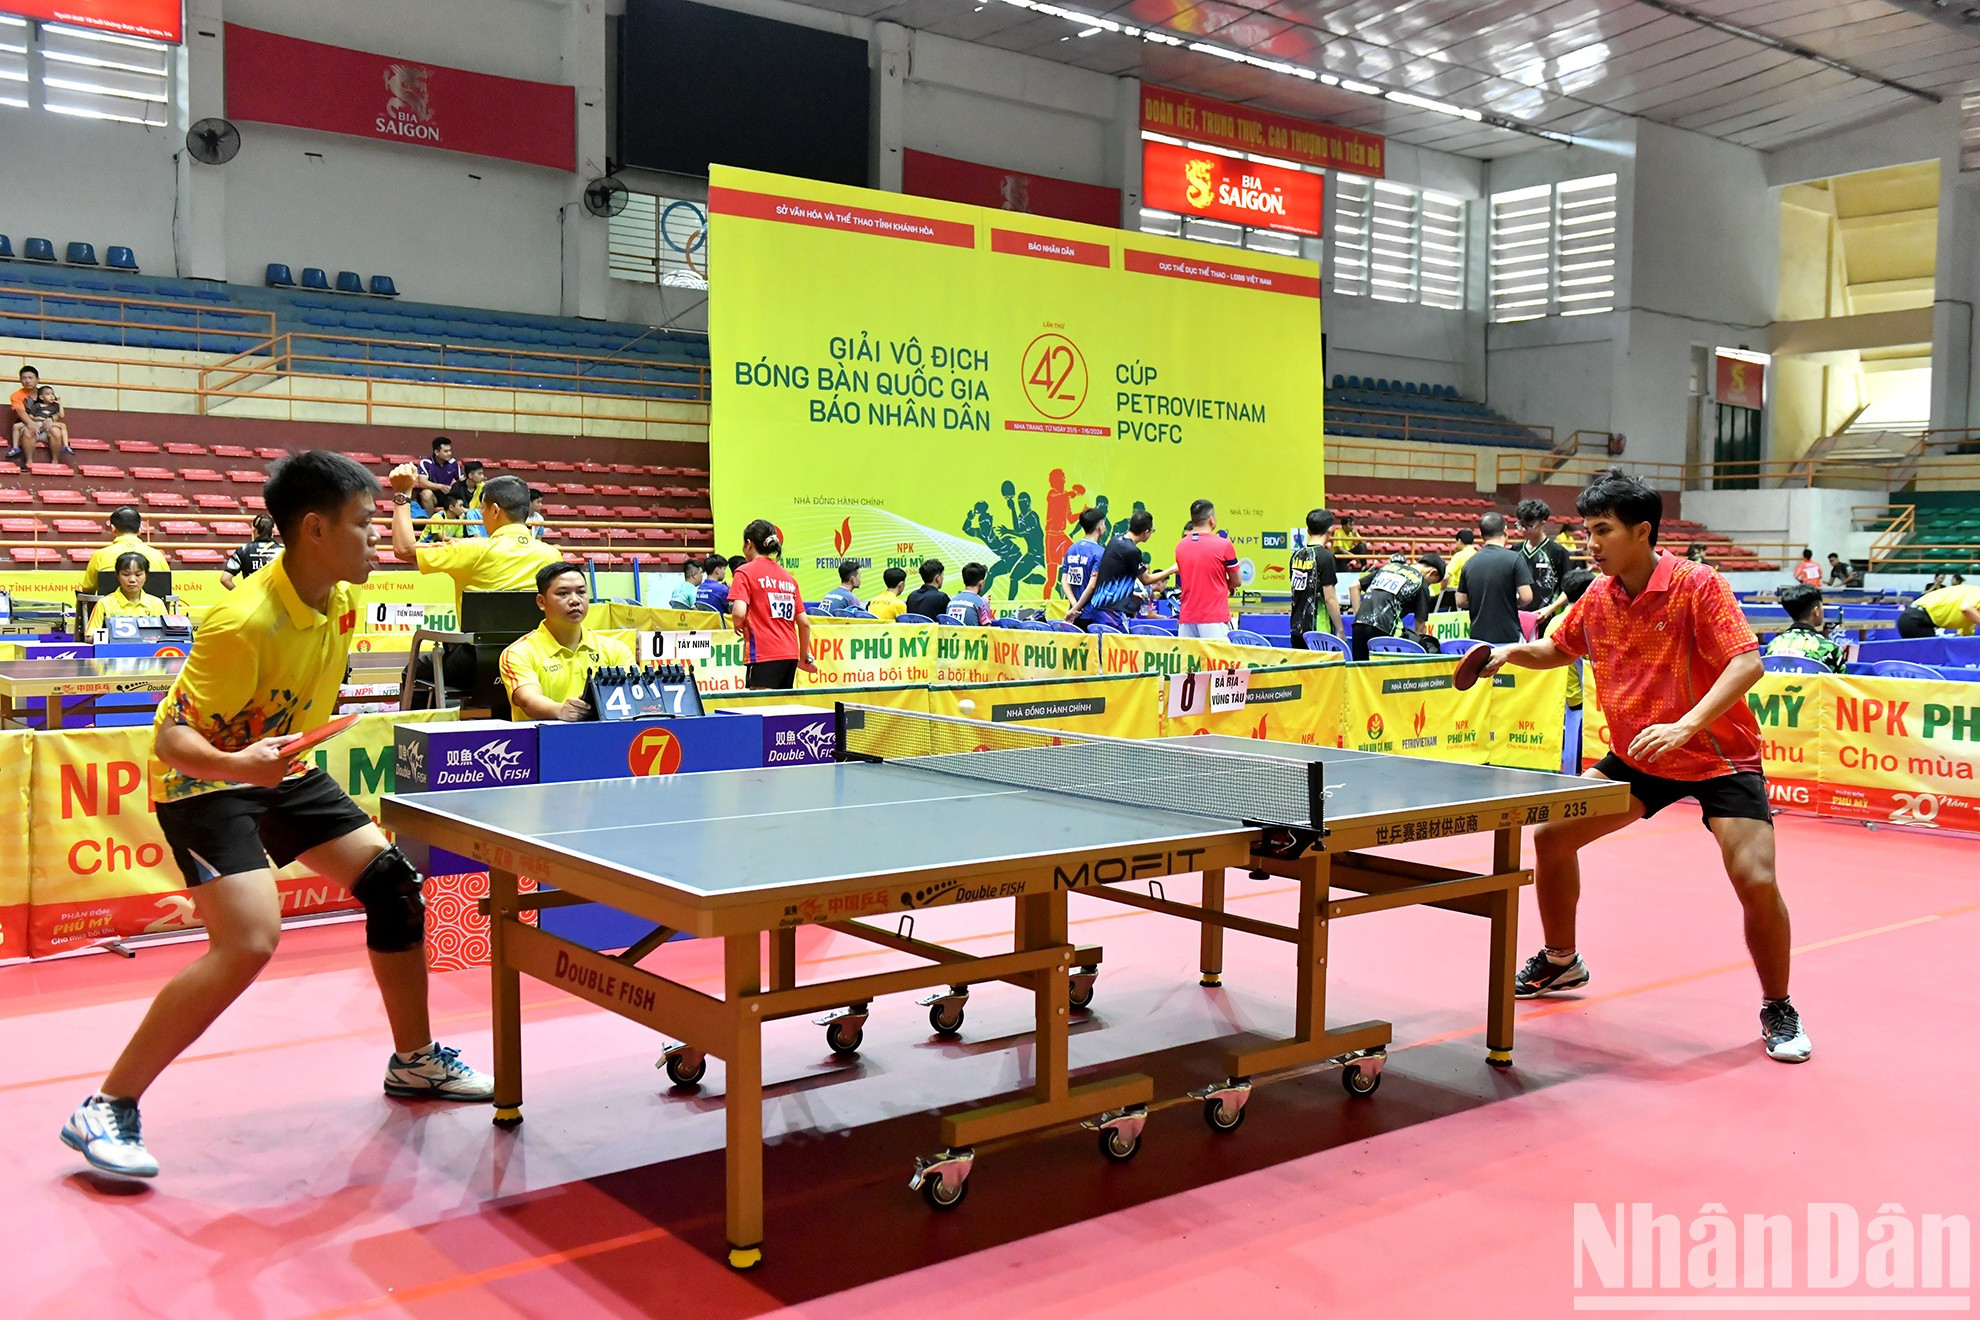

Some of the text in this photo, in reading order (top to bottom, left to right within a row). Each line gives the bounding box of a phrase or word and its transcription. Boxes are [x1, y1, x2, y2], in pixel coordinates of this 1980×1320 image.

[398, 112, 418, 122] BIA
[376, 118, 440, 141] SAIGON
[1202, 110, 1234, 138] TRUNG
[1268, 126, 1288, 148] CAO
[1242, 175, 1262, 190] BIA
[806, 210, 822, 220] HÓA
[824, 210, 834, 221] VÀ
[836, 212, 852, 224] THỂ
[853, 216, 874, 227] THAO
[893, 222, 918, 234] KHÁNH
[920, 226, 934, 236] HÒA
[1028, 242, 1074, 256] BÁO NHÂN DÂN
[1211, 270, 1226, 278] THAO
[1246, 274, 1258, 284] VIỆT
[829, 330, 989, 374] GIẢI VÔ ĐỊCH
[735, 356, 990, 402] BÓNG BÀN QUỐC GIA
[1028, 344, 1076, 400] 42
[1116, 359, 1158, 386] CÚP
[809, 394, 990, 432] BÁO NHÂN DÂN
[1116, 392, 1266, 424] PETROVIETNAM
[1117, 420, 1182, 444] PVCFC
[794, 494, 885, 506] NHÀ ĐỒNG HÀNH CHÍNH
[896, 543, 914, 554] NPK
[1230, 536, 1260, 544] VNPT
[887, 554, 925, 568] PHÚ MỸ
[34, 582, 69, 592] KHÁNH
[184, 581, 202, 592] DÂN
[377, 582, 394, 592] VIỆT
[758, 576, 777, 589] TÂY
[376, 604, 386, 622] 0
[408, 610, 424, 618] GIANG
[96, 630, 106, 642] T
[114, 617, 138, 637] 5
[1438, 618, 1460, 640] PHÚ
[652, 632, 664, 658] 0
[678, 639, 710, 649] TÂY NINH
[808, 630, 930, 662] NPK PHÚ MỸ
[938, 636, 958, 661] HÚ
[994, 640, 1090, 671] NPK PHÚ MỸ
[1108, 647, 1181, 674] NPK PHÚ
[808, 665, 929, 684] Cho mùa bội thu
[948, 666, 988, 682] bội thu
[1214, 676, 1239, 690] BÀ RỊA
[354, 687, 374, 696] NPK
[605, 682, 686, 716] 4 0 1 7
[1181, 673, 1196, 712] 0
[1212, 692, 1244, 706] VŨNG TÀU
[1256, 690, 1292, 700] HÀNH CHÍNH
[1006, 702, 1092, 718] NHÀ ĐỒNG HÀNH CHÍNH
[1748, 686, 1806, 728] MỸ
[1456, 720, 1469, 730] NPK
[1518, 720, 1535, 730] NPK
[1836, 696, 1910, 738] NPK
[1302, 733, 1316, 744] NPK
[1402, 736, 1438, 750] PETROVIETNAM
[1448, 730, 1476, 744] PHÚ MỸ
[1509, 732, 1544, 744] PHÚ MỸ
[640, 734, 670, 776] 7
[768, 748, 805, 762] Double
[1761, 740, 1804, 764] thu
[1838, 746, 1974, 780] Cho mùa
[437, 768, 531, 784] Double FISH
[1564, 801, 1588, 818] 235
[1888, 793, 1938, 822] 20
[1376, 814, 1478, 845] 世乒赛器材供应商
[68, 837, 164, 875] Cho
[1054, 848, 1206, 891] MOFIT
[278, 886, 328, 912] TIN
[955, 881, 1026, 902] Double FISH
[61, 908, 110, 920] PHÂN BÓN
[52, 936, 68, 945] Cho
[102, 926, 115, 935] thu
[53, 916, 113, 936] PHÚ MỸ
[554, 950, 656, 1012] DOUBLE FISH
